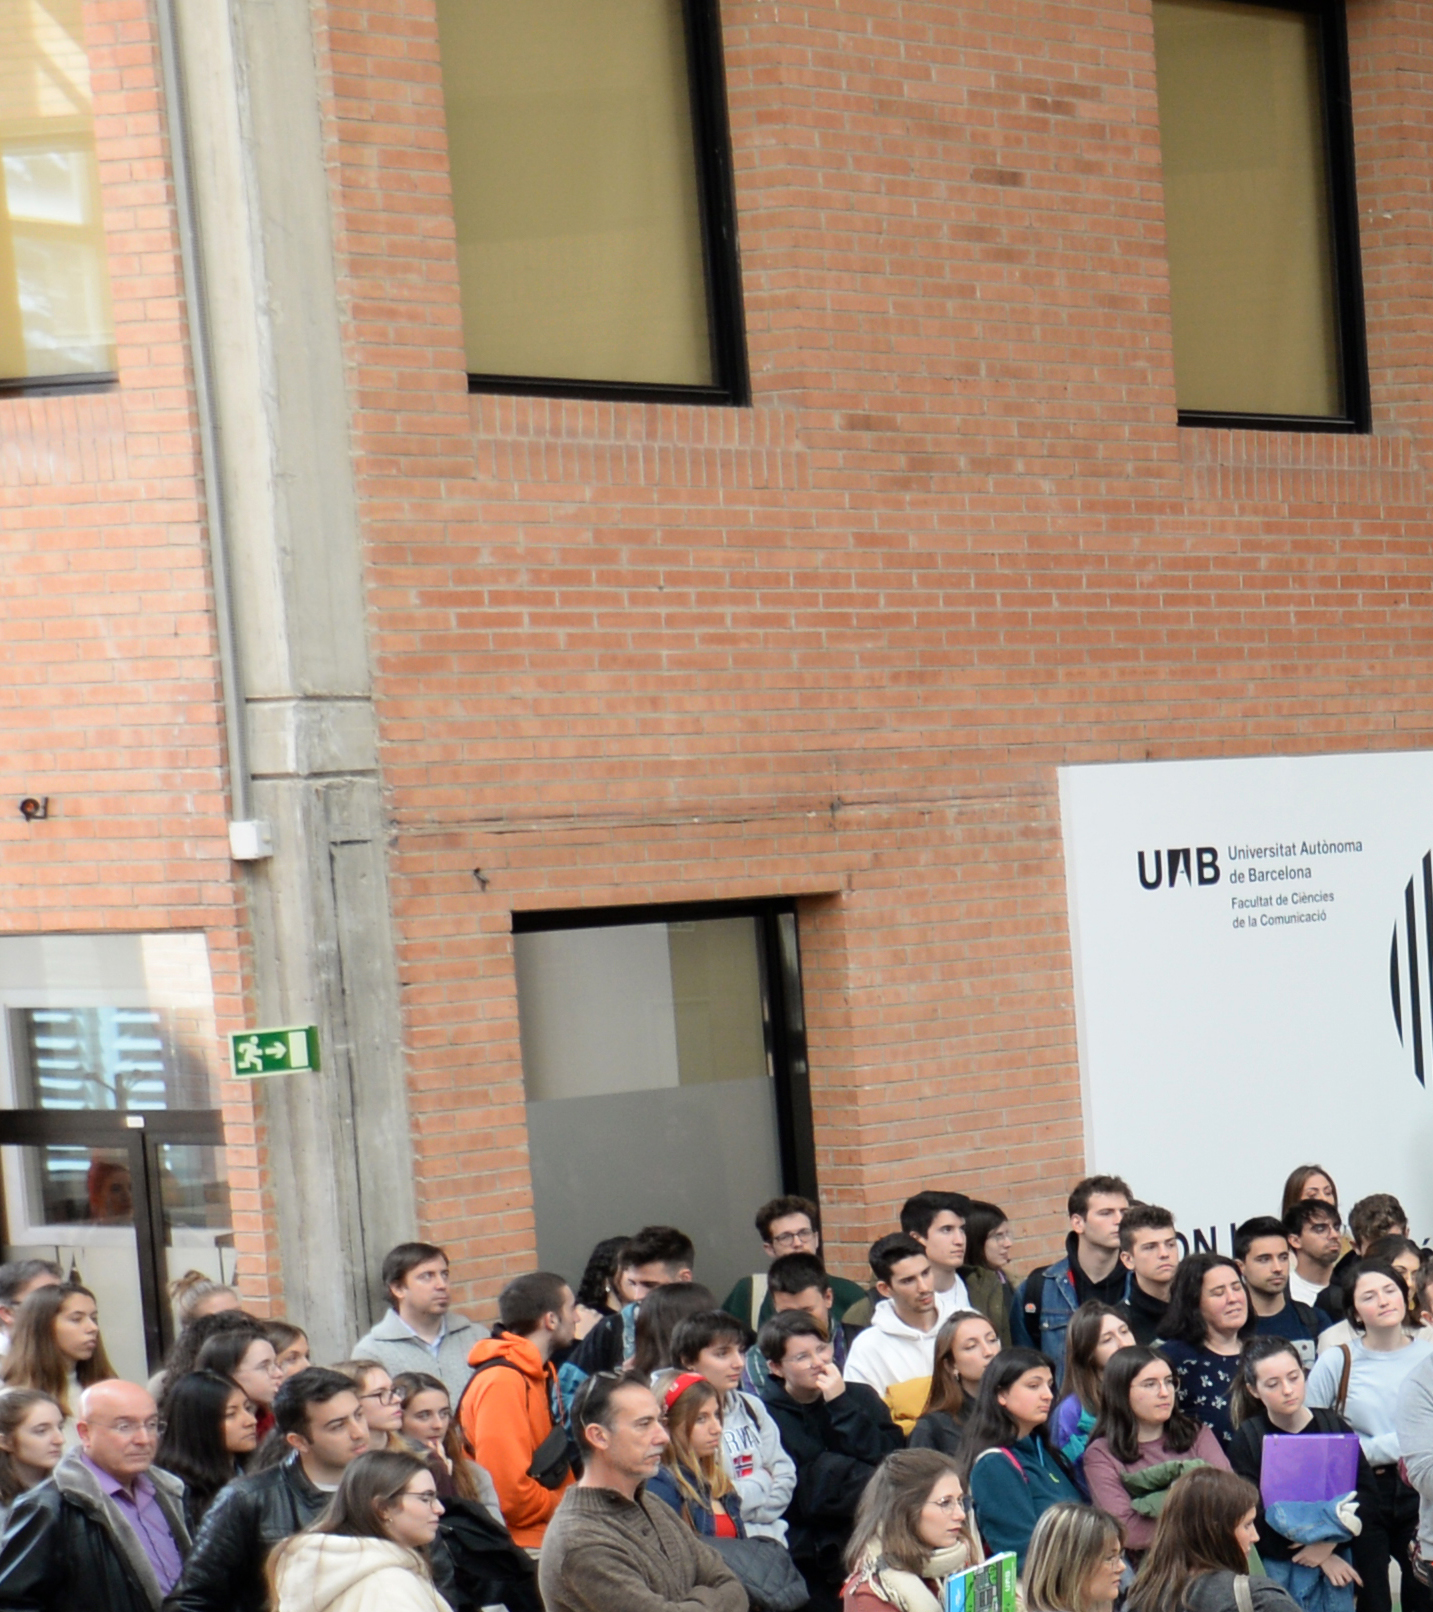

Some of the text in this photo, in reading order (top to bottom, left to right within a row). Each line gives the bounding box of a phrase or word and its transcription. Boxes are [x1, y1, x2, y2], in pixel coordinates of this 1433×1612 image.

[1227, 839, 1363, 861] Universitat Autònoma
[1137, 846, 1221, 890] UAB
[1229, 866, 1312, 884] de Barcelona
[1231, 891, 1334, 910] Facultat de Ciències
[1232, 909, 1327, 929] de la Comunicació
